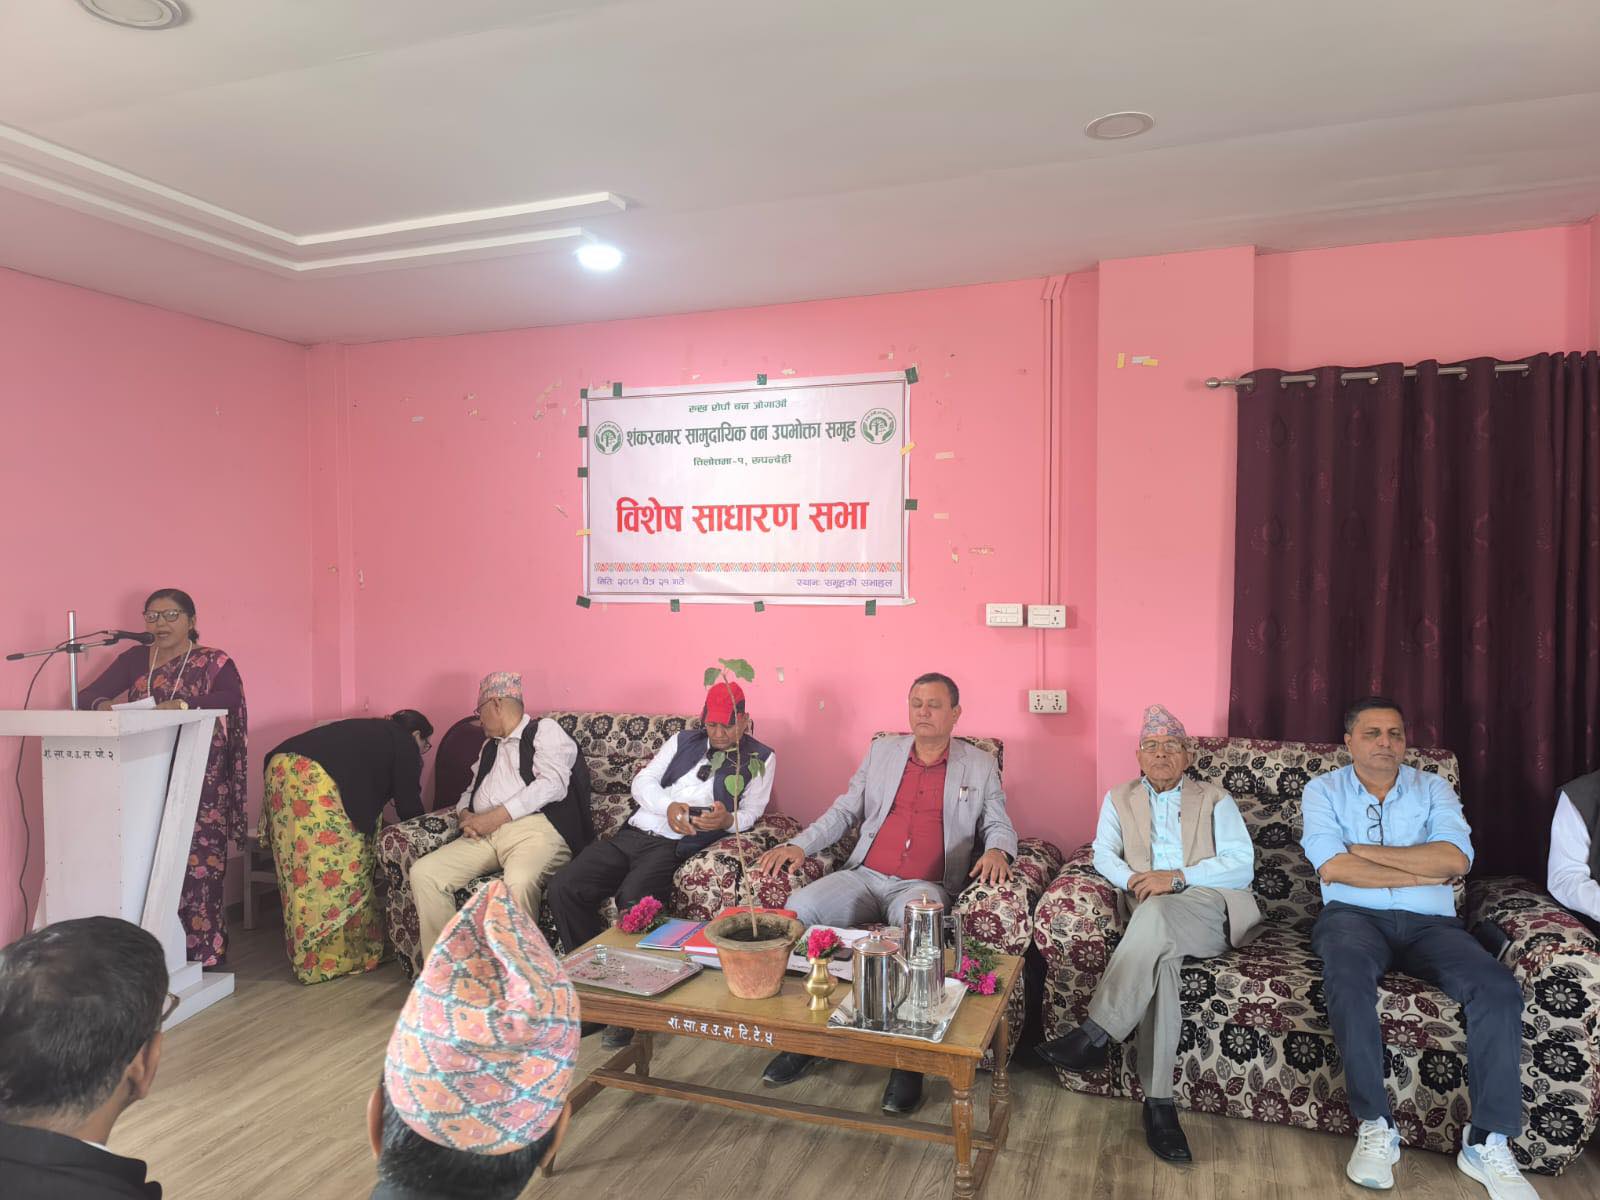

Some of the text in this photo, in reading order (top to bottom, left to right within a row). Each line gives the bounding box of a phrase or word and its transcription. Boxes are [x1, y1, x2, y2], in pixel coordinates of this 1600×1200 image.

[734, 402, 750, 411] वन
[626, 421, 682, 447] शंकरनगर
[684, 422, 747, 448] सामुदायिक
[750, 425, 769, 442] वन
[772, 418, 821, 440] उपभोक्ता
[825, 420, 858, 443] समूह
[616, 496, 870, 535] विशेष साधारण सभा
